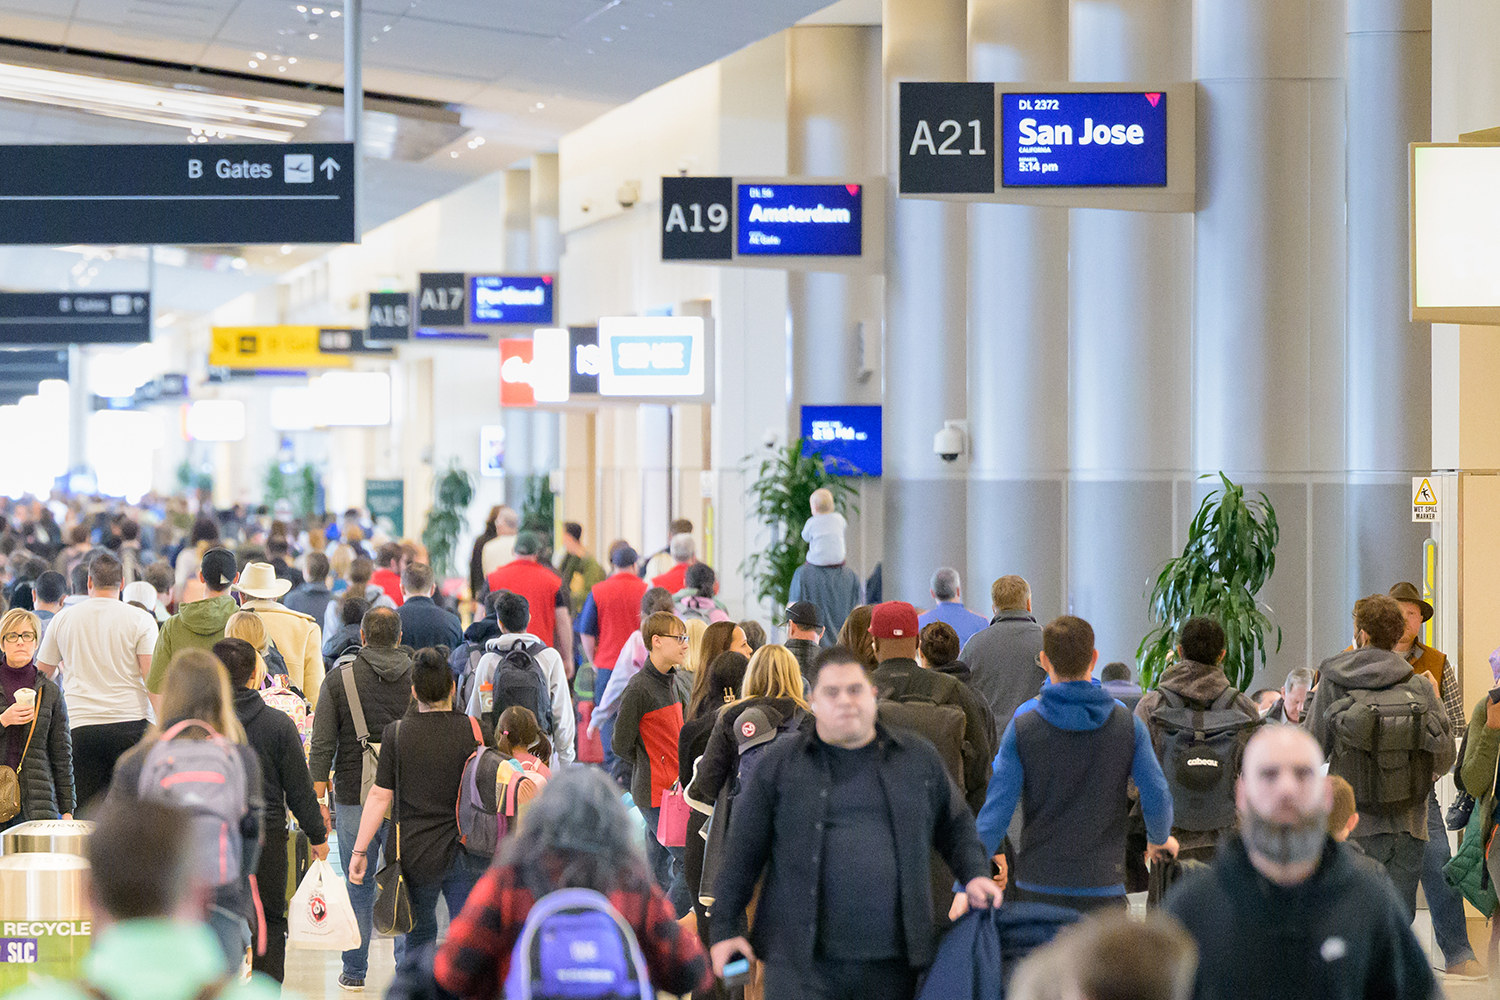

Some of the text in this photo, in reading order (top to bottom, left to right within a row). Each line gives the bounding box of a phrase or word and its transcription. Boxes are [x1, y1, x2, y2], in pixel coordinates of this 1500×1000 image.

[1018, 99, 1060, 110] DL 2372
[909, 119, 986, 155] A21
[1018, 118, 1145, 145] San Jose
[188, 158, 274, 179] B Gates
[1018, 161, 1059, 174] 5:14 pm
[665, 203, 729, 233] A19
[749, 203, 851, 224] Amsterdam
[420, 287, 464, 311] A17
[4, 921, 91, 936] RECYCLE
[7, 941, 35, 963] SLC
